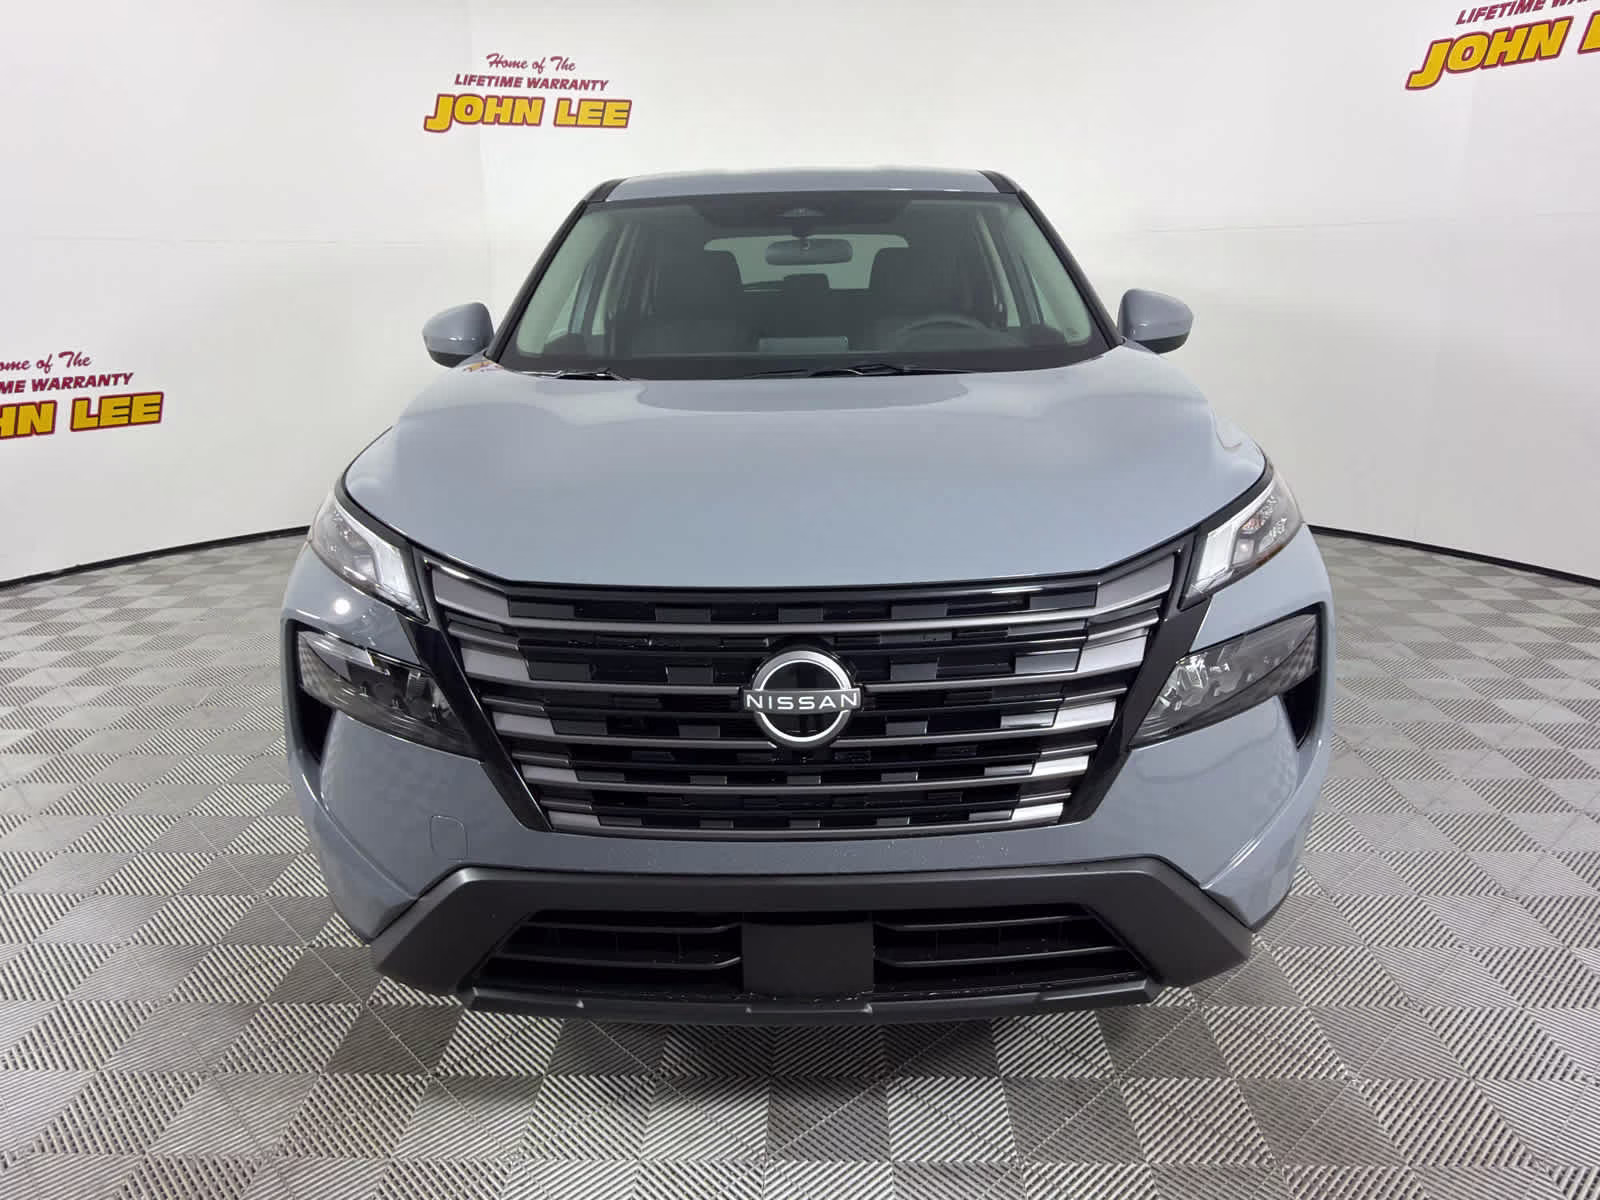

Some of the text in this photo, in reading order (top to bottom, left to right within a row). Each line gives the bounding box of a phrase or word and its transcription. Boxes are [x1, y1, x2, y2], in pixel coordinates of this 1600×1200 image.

[486, 53, 576, 74] Home of The
[1405, 16, 1574, 90] JOHN
[454, 74, 609, 91] LIFETIME WARRANTY
[424, 93, 632, 133] JOHN LEE
[35, 353, 54, 374] of
[58, 351, 91, 368] The
[31, 372, 134, 392] WARRANTY
[70, 392, 164, 432] LEE
[746, 692, 857, 710] NISSAN
